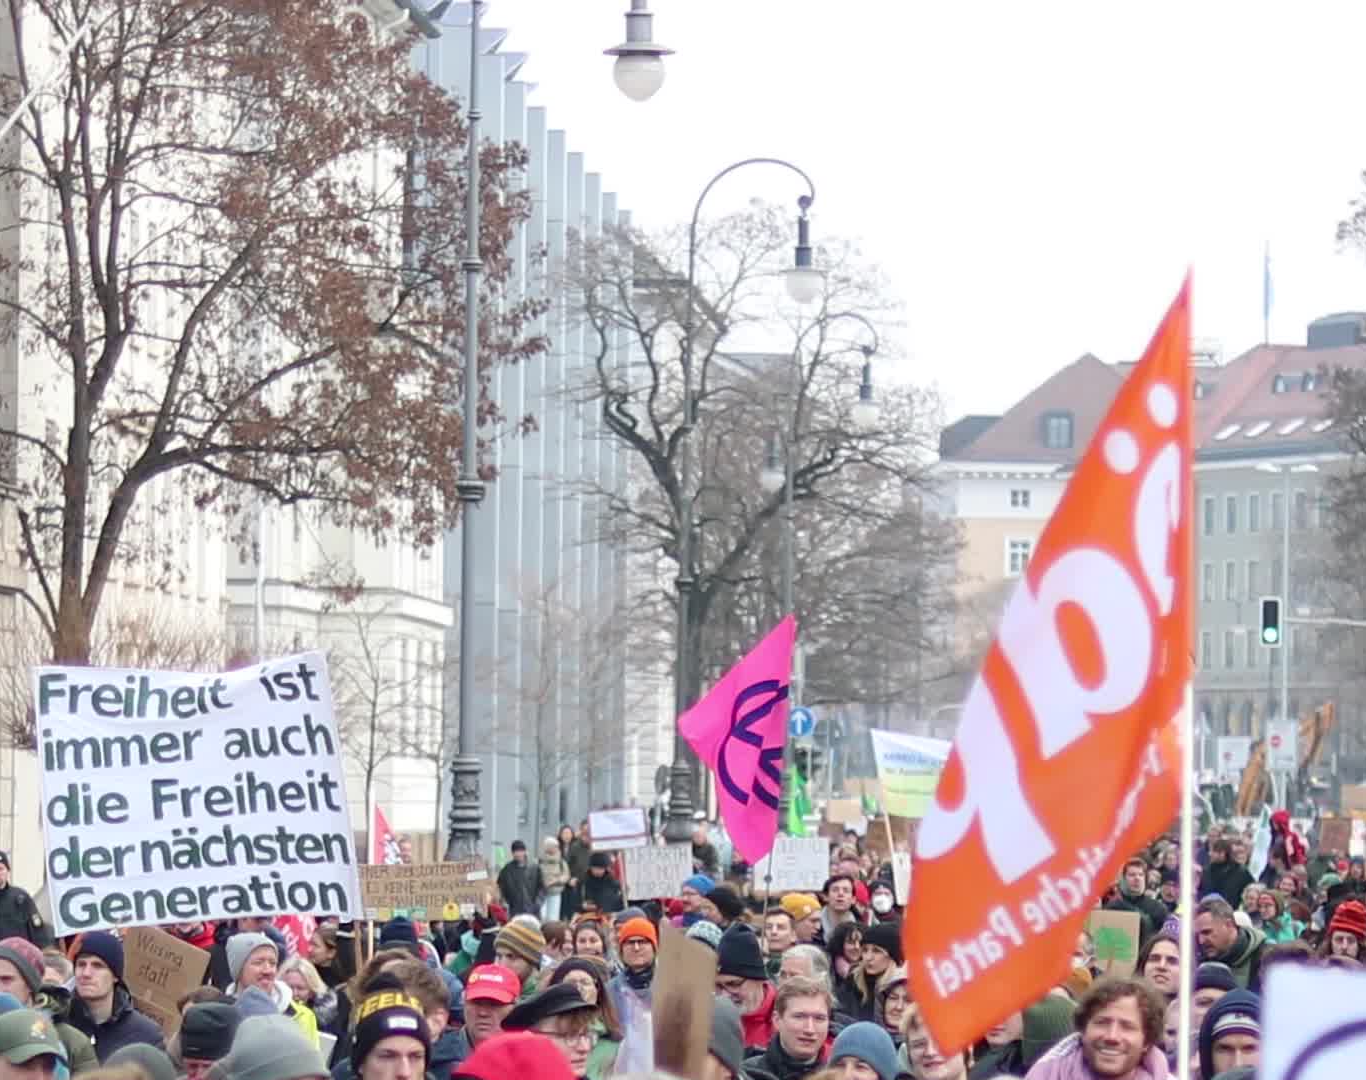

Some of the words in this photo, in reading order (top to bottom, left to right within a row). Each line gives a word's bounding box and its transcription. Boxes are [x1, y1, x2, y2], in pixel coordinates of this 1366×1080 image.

[39, 673, 233, 720] Freiheit
[259, 662, 320, 702] ist
[42, 725, 203, 772] immer
[223, 714, 336, 761] auch
[46, 783, 130, 828] die
[151, 770, 343, 820] Freiheit
[48, 836, 137, 881] der
[140, 824, 351, 874] nächsten
[58, 871, 350, 930] Generation
